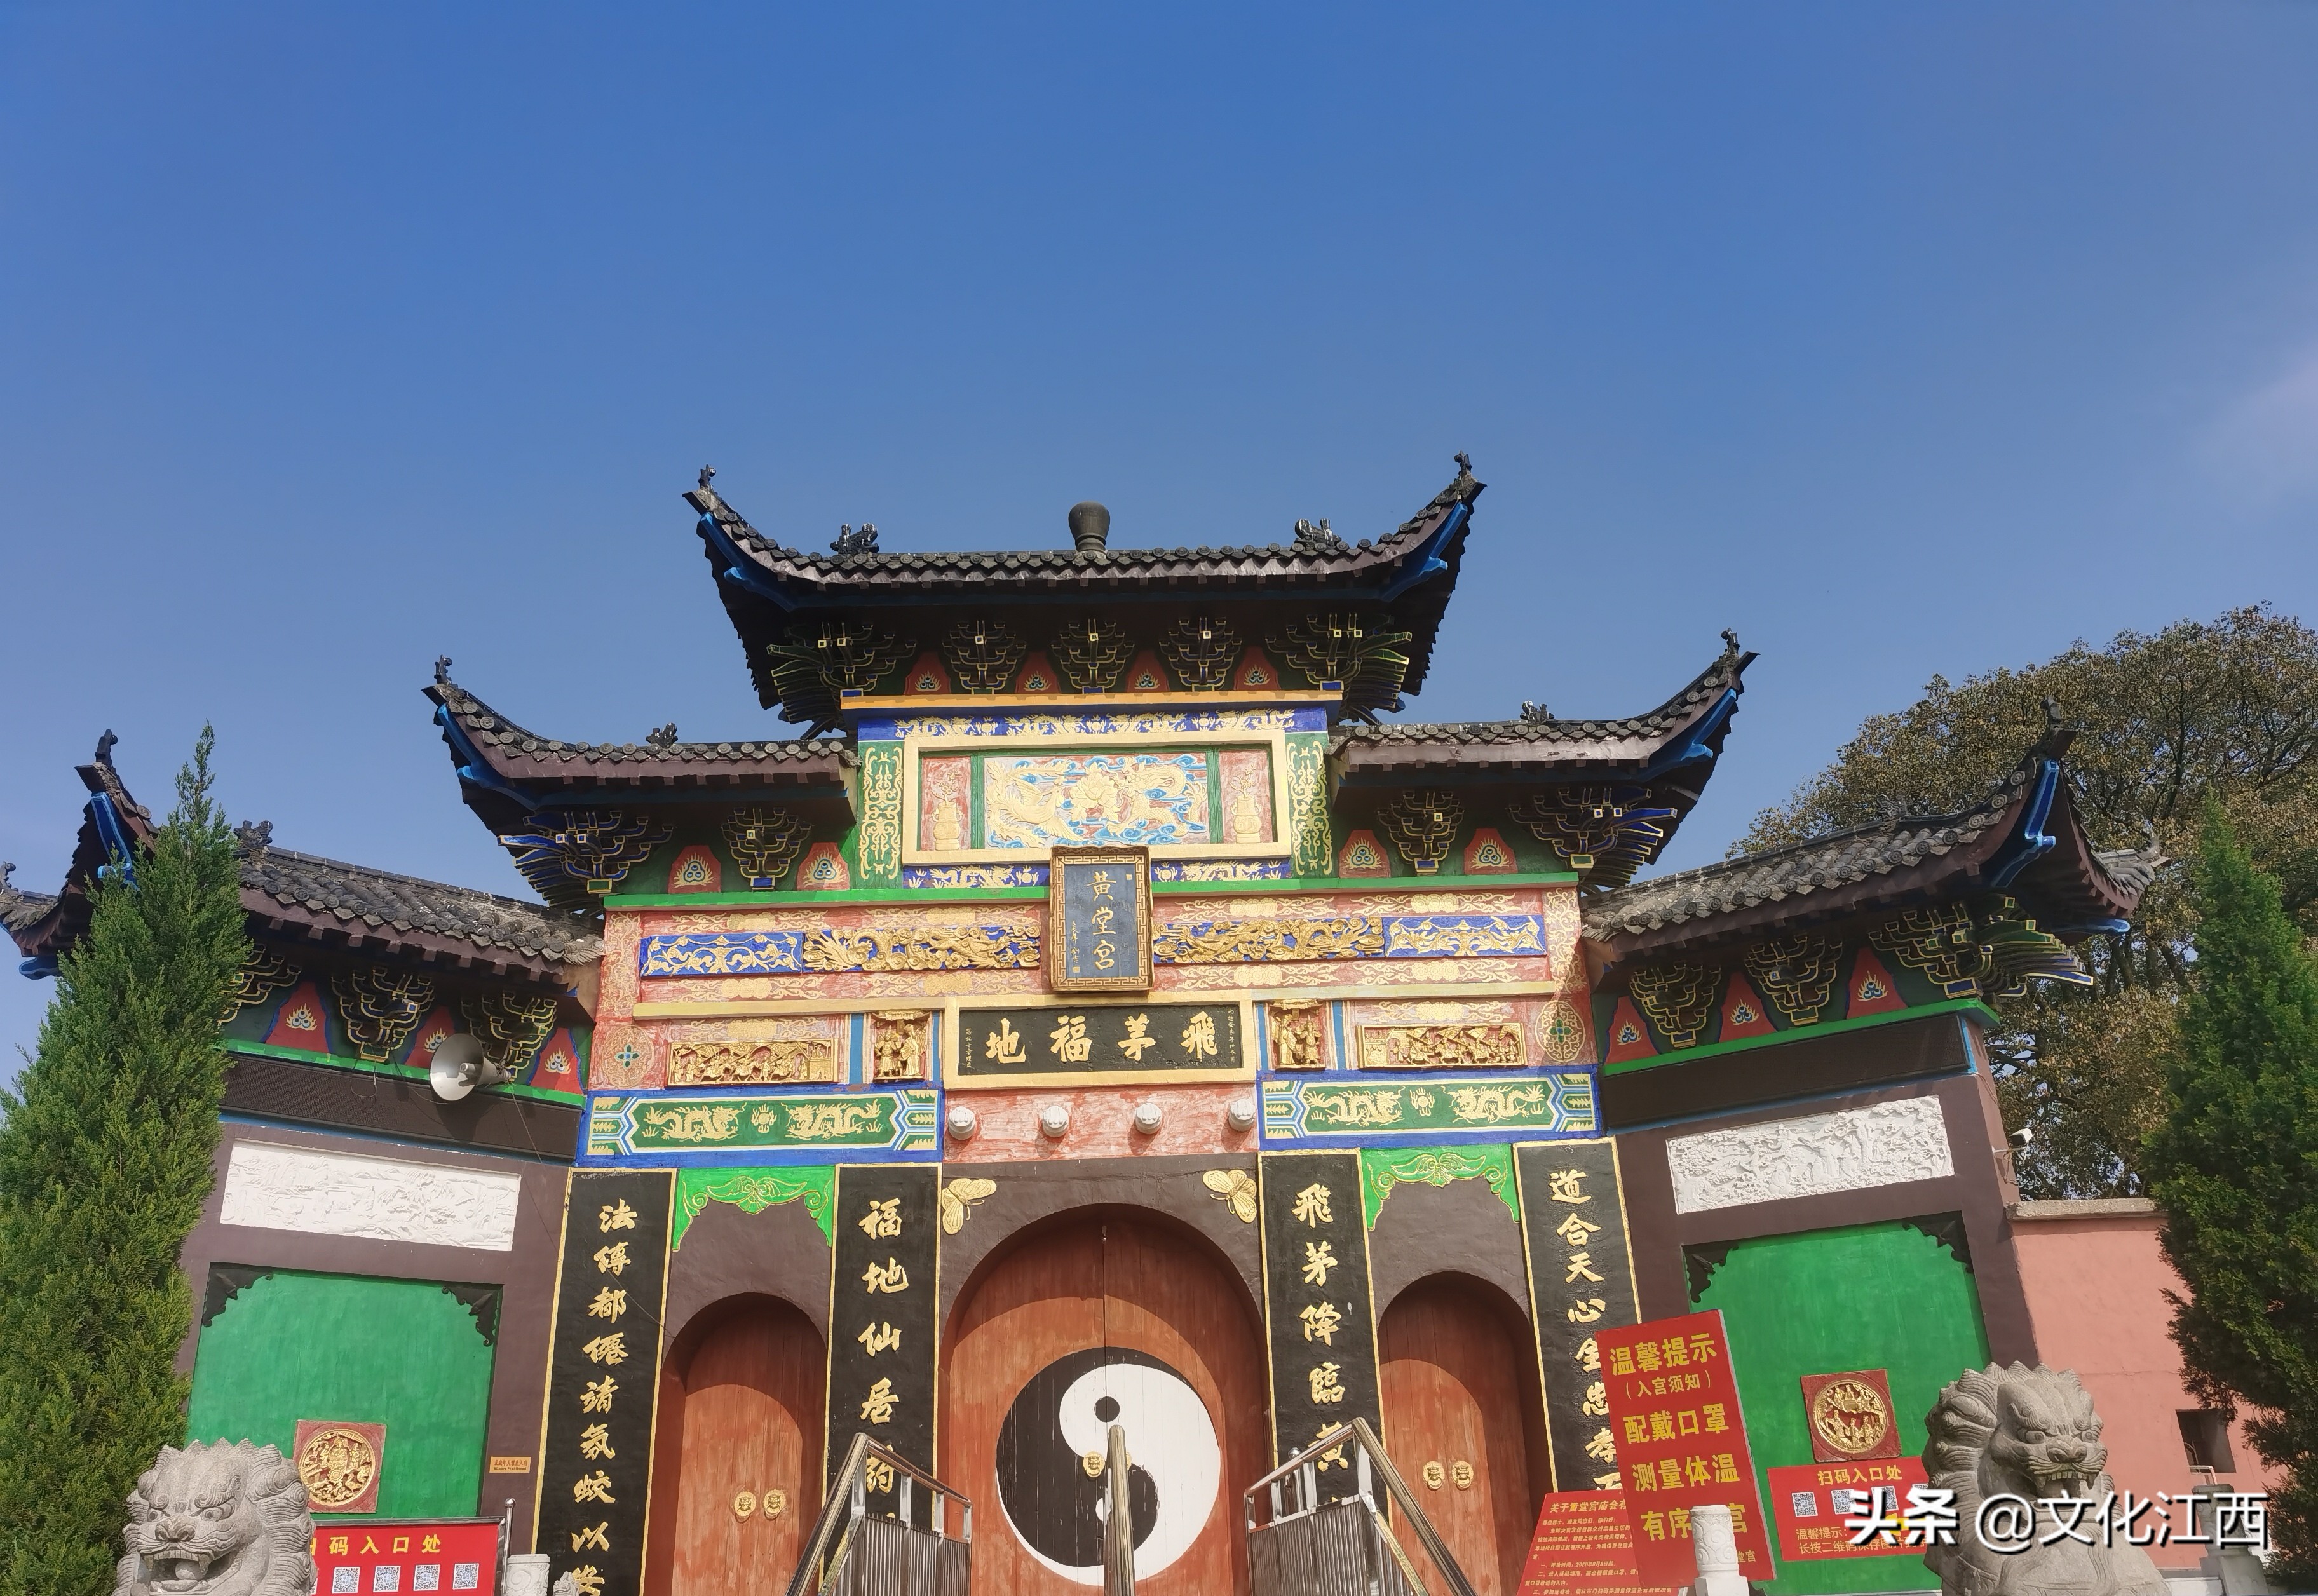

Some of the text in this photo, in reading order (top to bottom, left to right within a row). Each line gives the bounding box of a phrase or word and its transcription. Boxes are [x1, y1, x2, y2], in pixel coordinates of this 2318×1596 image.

[1086, 870, 1117, 970] 黄堂宫
[1292, 1183, 1348, 1502] 飛茅降臨黄
[1610, 1332, 1717, 1376] 温馨提示
[1625, 1369, 1711, 1400] （入宫须知）
[1623, 1403, 1730, 1445] 配戴口罩
[1632, 1453, 1740, 1493] 测量体温
[1817, 1464, 1902, 1486] 扫码入口处
[1641, 1502, 1748, 1541] 有序宫
[1796, 1526, 1848, 1541] 温馨提示：
